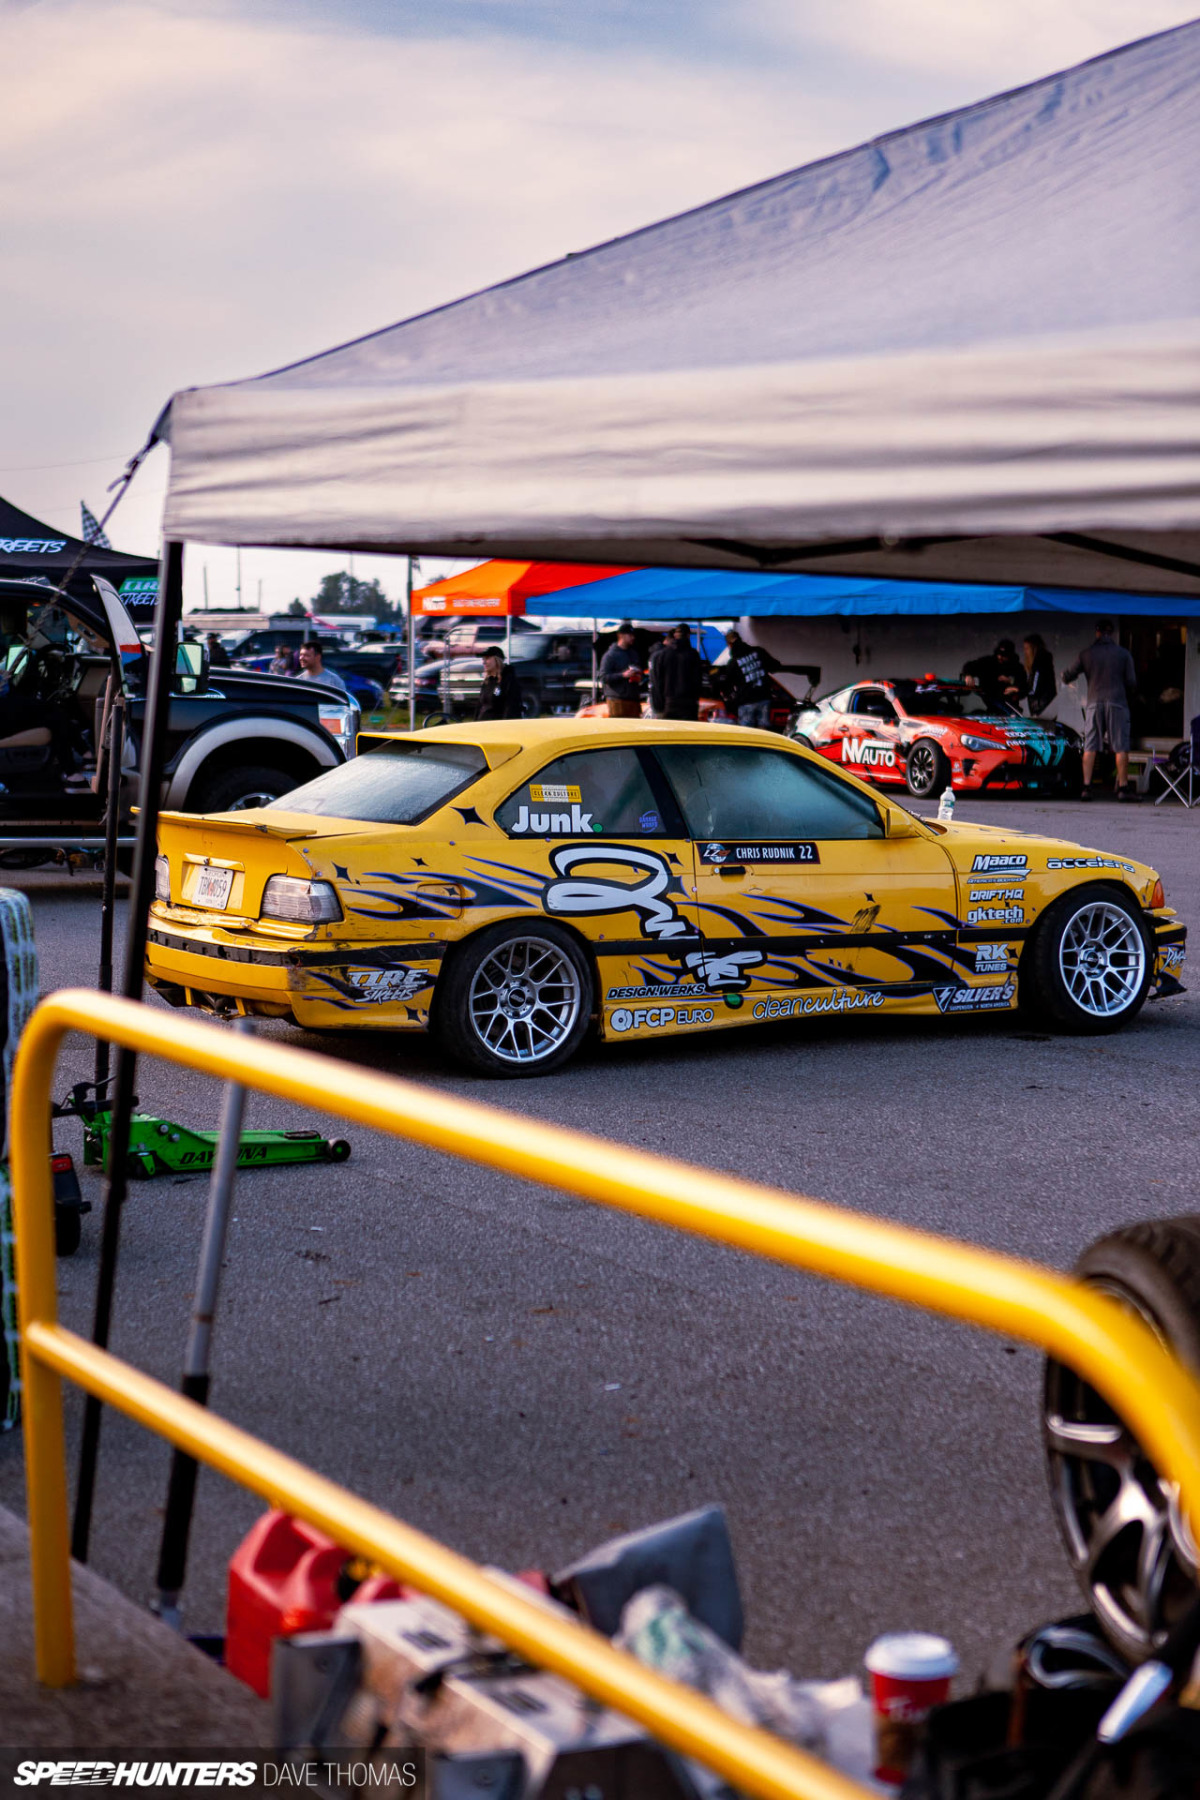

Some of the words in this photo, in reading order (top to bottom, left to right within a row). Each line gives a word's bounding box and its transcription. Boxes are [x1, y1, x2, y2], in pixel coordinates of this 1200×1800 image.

[124, 579, 160, 591] TIR
[736, 847, 760, 859] CHRIS
[762, 847, 795, 859] RUDNIK
[798, 845, 813, 859] 22
[972, 855, 1027, 870] Maaco
[968, 905, 1023, 924] gktech
[975, 943, 1009, 961] RK
[975, 963, 1007, 972] TUNES
[347, 969, 429, 987] TIRE
[354, 984, 418, 1005] STREETS
[952, 983, 1016, 1004] SILVER'S
[633, 1007, 675, 1029] FCP
[677, 1008, 714, 1025] EURO
[180, 1146, 268, 1164] DAYNA
